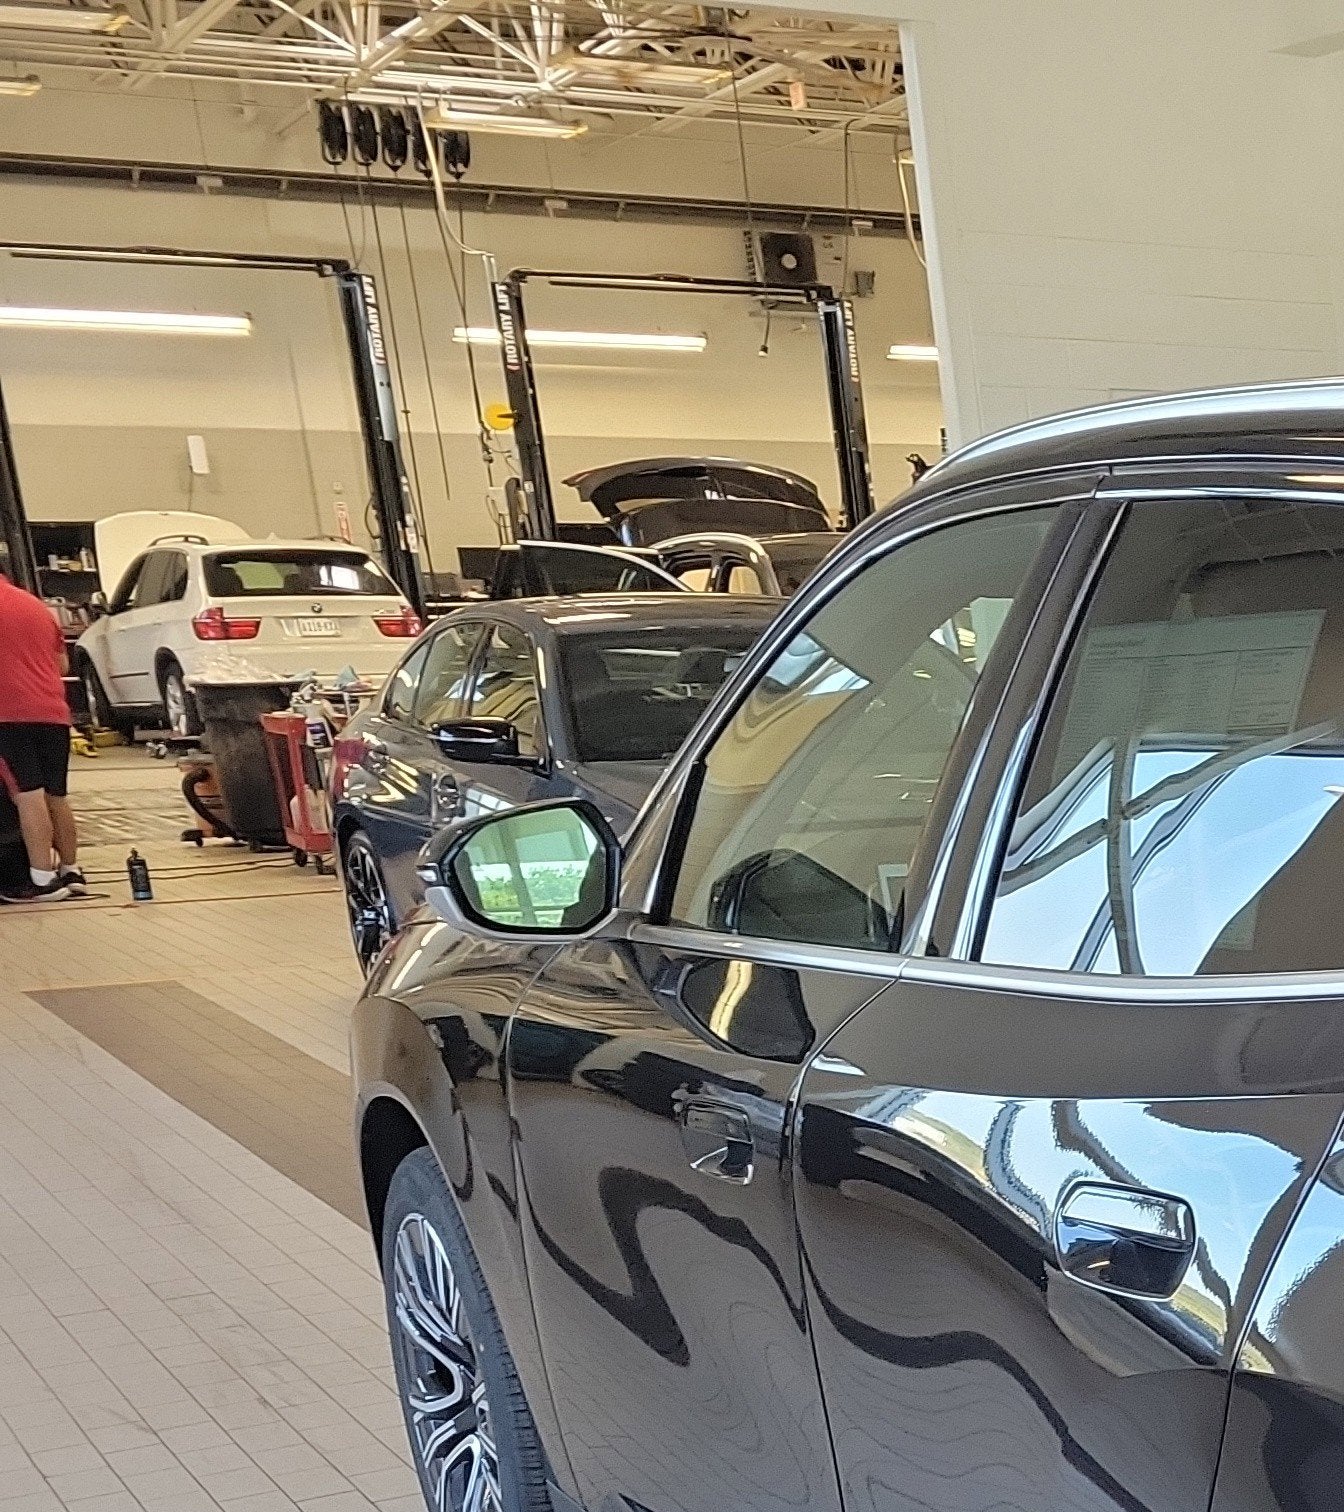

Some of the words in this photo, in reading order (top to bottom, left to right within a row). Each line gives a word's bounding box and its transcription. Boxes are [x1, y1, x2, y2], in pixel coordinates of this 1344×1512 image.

[361, 275, 377, 304] LIFT
[366, 305, 387, 359] ROTARY
[499, 312, 521, 363] ROTARY
